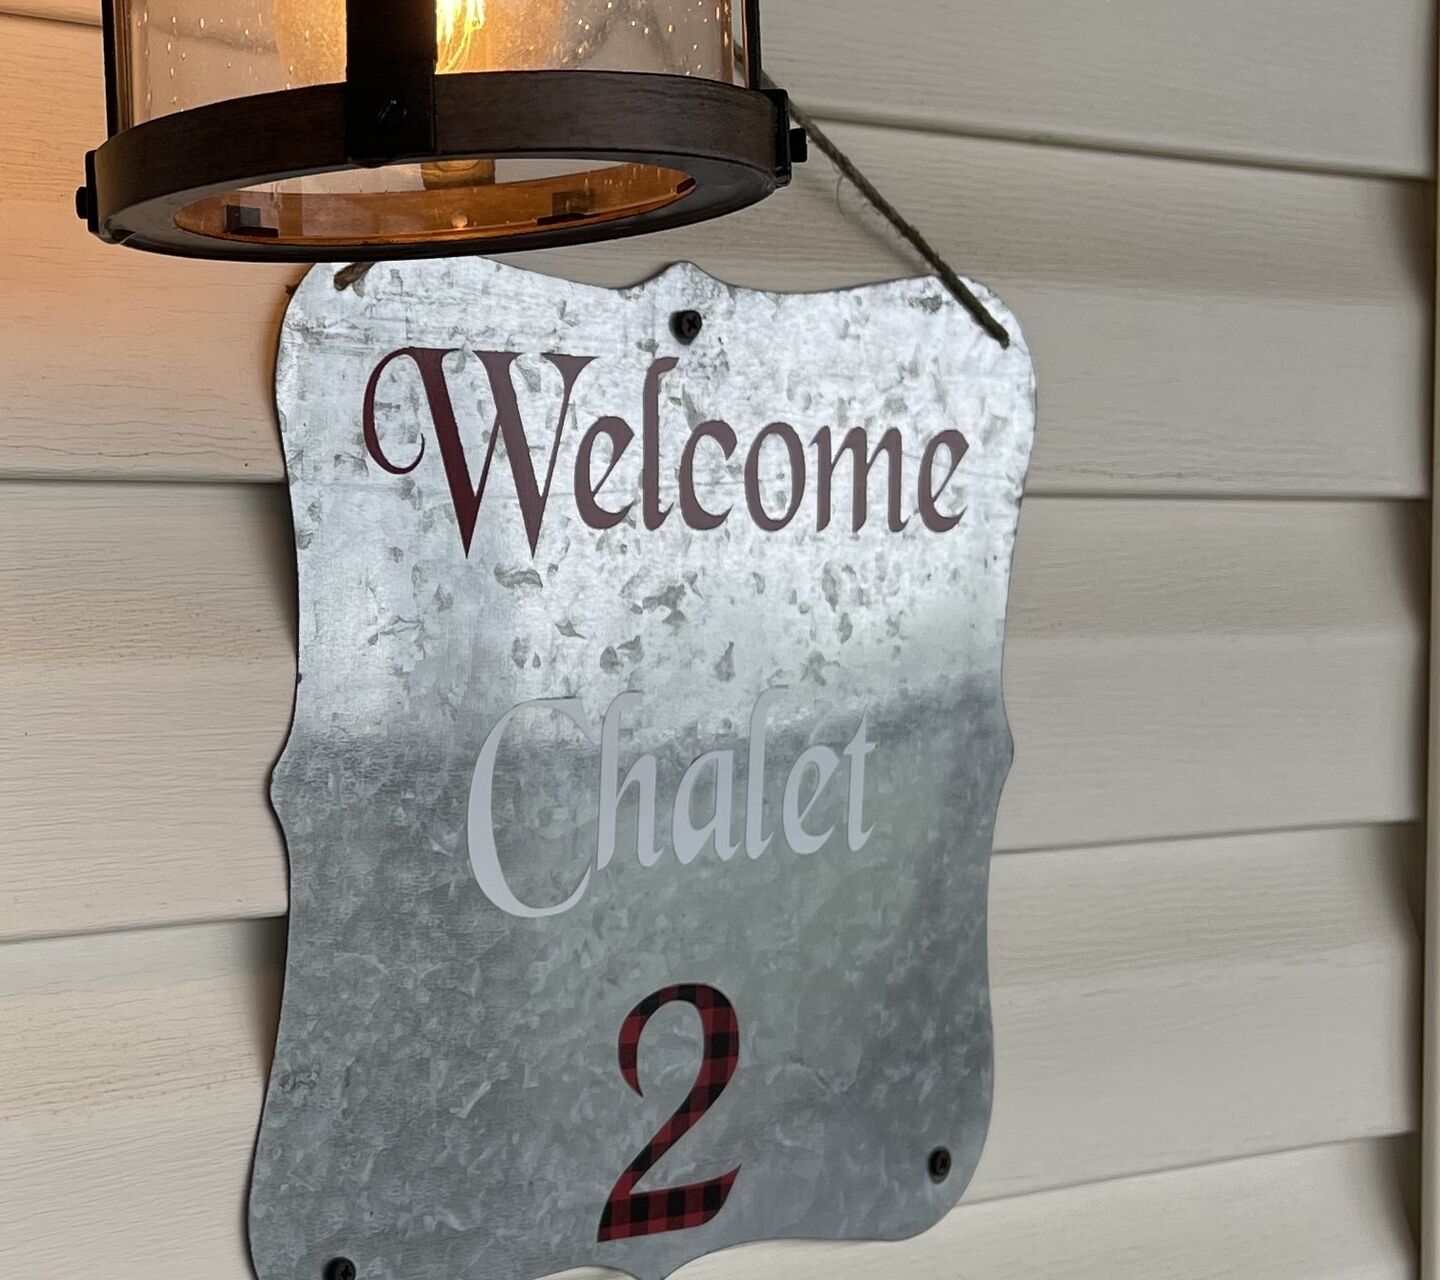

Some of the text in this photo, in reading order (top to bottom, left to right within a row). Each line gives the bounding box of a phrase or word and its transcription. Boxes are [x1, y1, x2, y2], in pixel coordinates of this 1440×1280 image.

[362, 346, 971, 559] Welcome
[468, 685, 879, 918] Chalet
[597, 983, 742, 1244] 2
